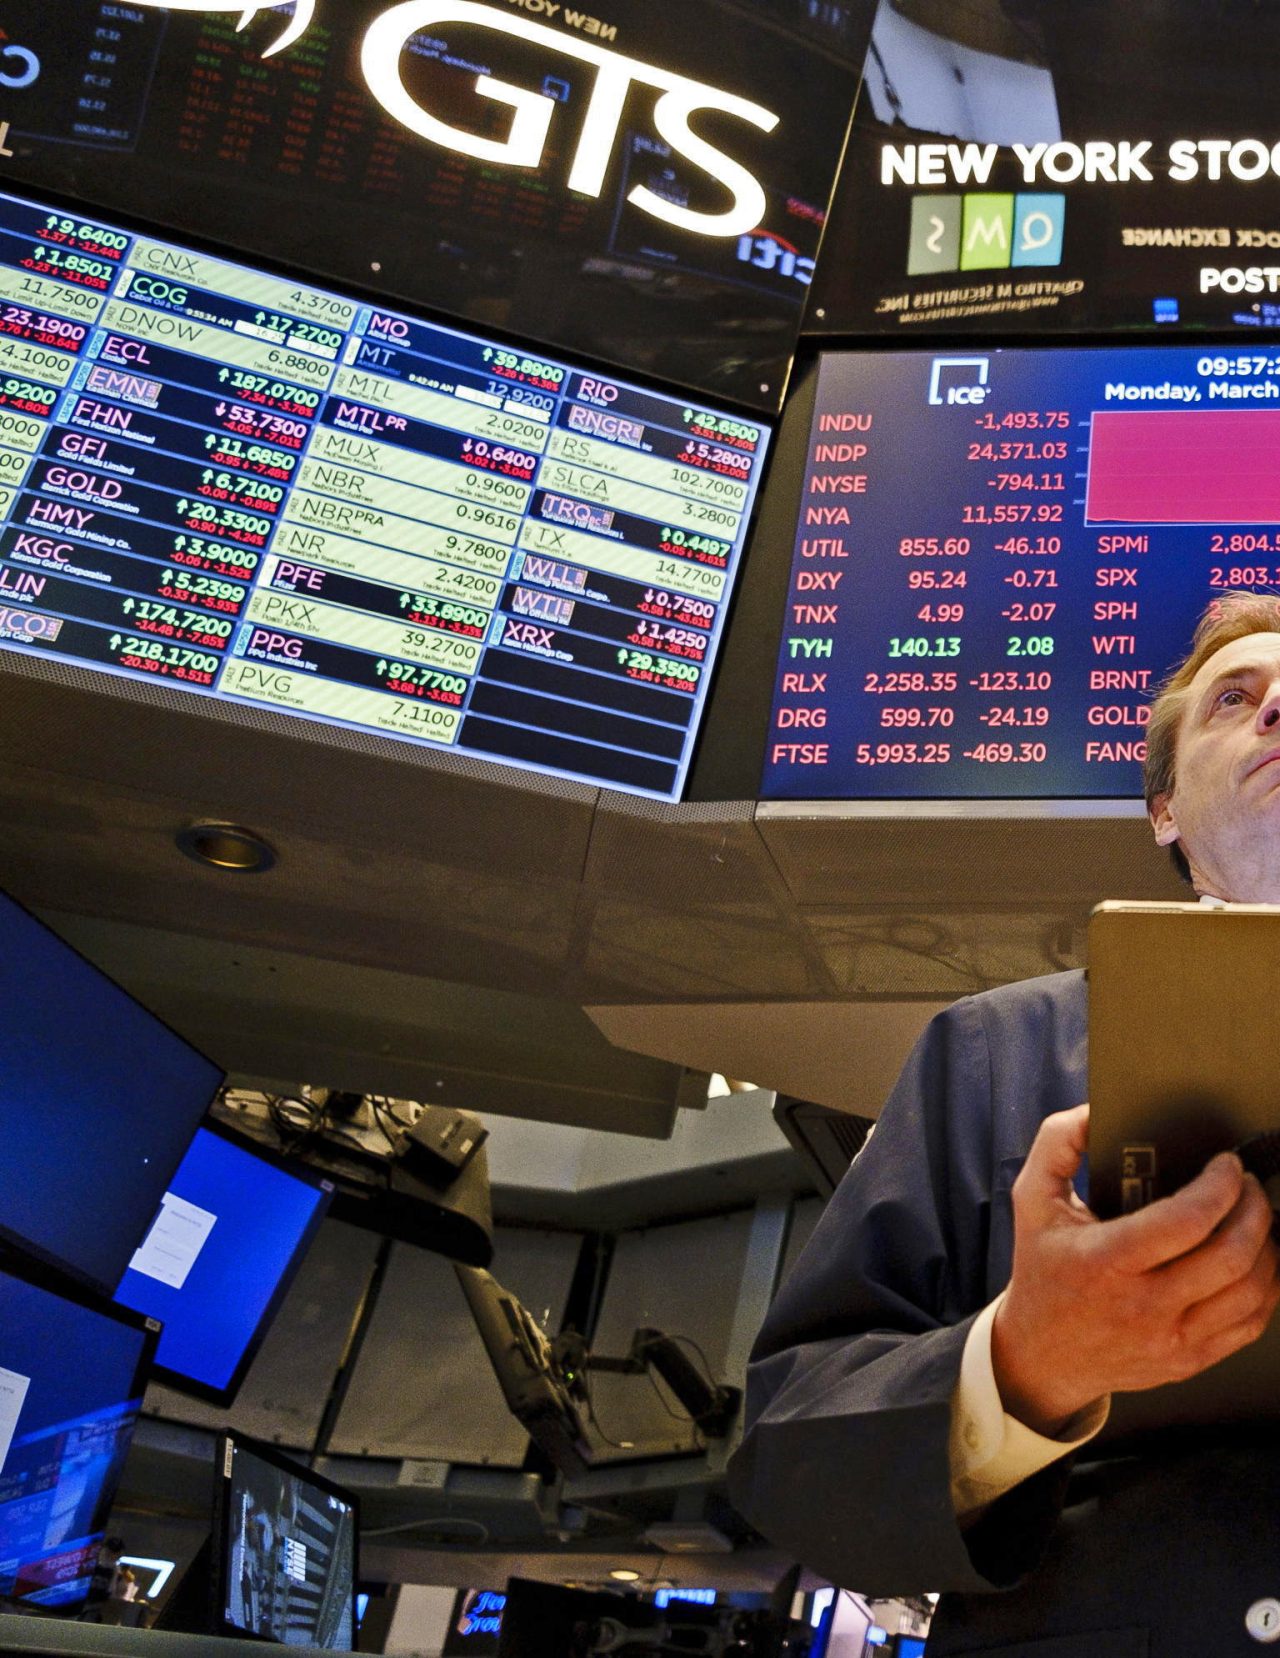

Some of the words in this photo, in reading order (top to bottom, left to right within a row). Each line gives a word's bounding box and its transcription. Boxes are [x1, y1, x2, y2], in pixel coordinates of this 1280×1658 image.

[360, 0, 781, 237] GTS
[881, 143, 998, 185] NEW
[1012, 141, 1153, 183] YORK
[59, 220, 128, 250] 9.6400
[148, 248, 199, 274] CNX
[20, 278, 99, 309] 11.7500
[120, 306, 202, 342] DNOW
[132, 276, 188, 306] COG
[268, 315, 342, 348] 17.2700
[104, 336, 150, 365] ECL
[230, 370, 319, 408] 187.0700
[579, 378, 618, 402] RIO
[1105, 383, 1201, 402] Monday,
[1209, 381, 1279, 398] March
[819, 414, 872, 431] INDU
[975, 413, 1070, 430] -1,493.75
[61, 433, 108, 458] GFI
[326, 435, 383, 462] MUX
[815, 445, 867, 462] INDP
[968, 443, 1067, 462] 24,371.03
[46, 467, 122, 500] GOLD
[810, 476, 867, 493] NYSE
[987, 474, 1064, 491] -794.11
[30, 500, 94, 529] HMY
[806, 508, 850, 525] NYA
[962, 506, 1063, 525] 11,557.92
[802, 540, 848, 557] UTIL
[900, 539, 970, 556] 855.60
[994, 537, 1061, 554] -46.10
[1098, 535, 1148, 553] SPMi
[14, 533, 74, 564] KGC
[174, 572, 246, 603] 5.2399
[797, 572, 842, 590] DXY
[908, 571, 967, 589] 95.24
[1004, 570, 1058, 587] -0.71
[1096, 569, 1137, 586] SPX
[135, 602, 232, 638] 174.7200
[411, 596, 488, 628] 33.8900
[793, 605, 838, 623] TNX
[917, 604, 964, 622] 4.99
[1001, 603, 1056, 621] -2.07
[1094, 603, 1137, 620] SPH
[122, 637, 218, 674] 218.1700
[505, 620, 555, 648] XRX
[627, 651, 699, 682] 29.3500
[788, 638, 833, 658] TYH
[888, 637, 961, 658] 140.13
[1006, 636, 1054, 656] 2.08
[1092, 636, 1135, 655] WTI
[250, 630, 304, 658] PPG
[389, 663, 466, 694] 97.7700
[783, 673, 827, 692] RLX
[864, 673, 957, 694] 2,258.35
[969, 672, 1051, 690] -123.10
[1090, 671, 1151, 690] BRNT
[238, 666, 293, 694] PVG
[392, 701, 455, 728] 7.1100
[777, 709, 827, 728] DRG
[880, 708, 954, 727] 599.70
[979, 707, 1049, 726] -24.19
[1088, 707, 1151, 725] GOLD
[772, 745, 829, 764] FTSE
[856, 744, 950, 765] 5,993.25
[963, 743, 1047, 763] -469.30
[1086, 743, 1149, 762] FANG
